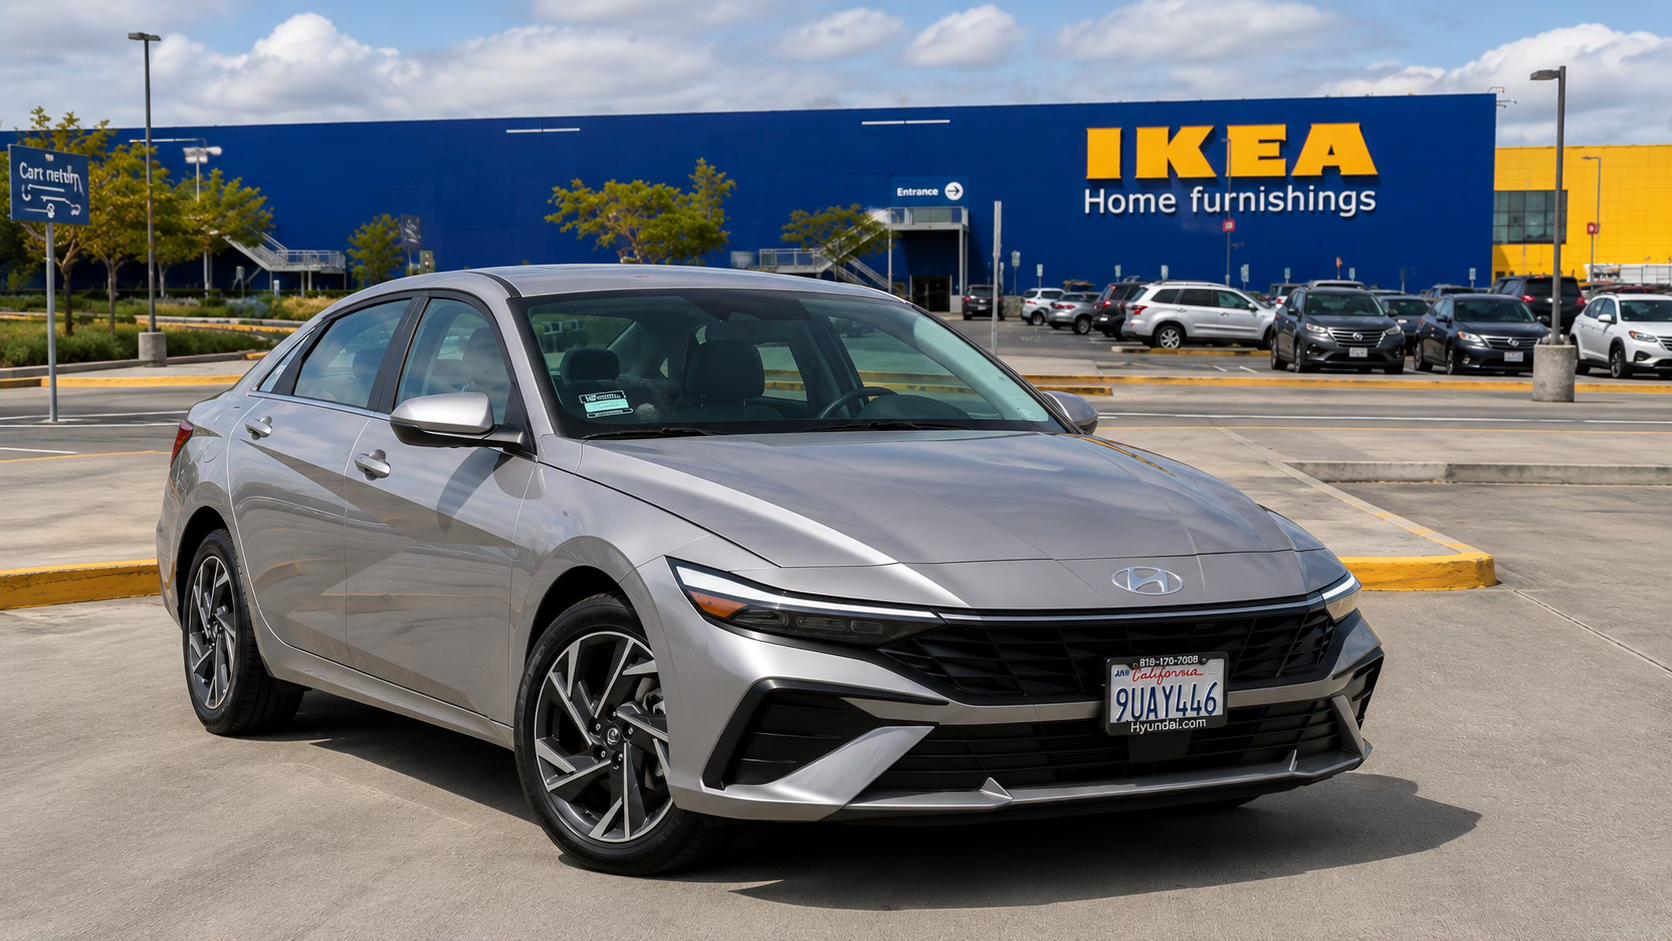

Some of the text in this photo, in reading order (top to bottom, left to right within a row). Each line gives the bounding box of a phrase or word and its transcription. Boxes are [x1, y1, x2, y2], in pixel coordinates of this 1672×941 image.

[1087, 123, 1379, 179] IKEA
[20, 162, 43, 180] Cart
[897, 187, 939, 197] Entrance
[1084, 185, 1377, 217] Home furnishings
[1116, 682, 1218, 722] 9UAY446
[1131, 719, 1207, 735] Hyundai.com
